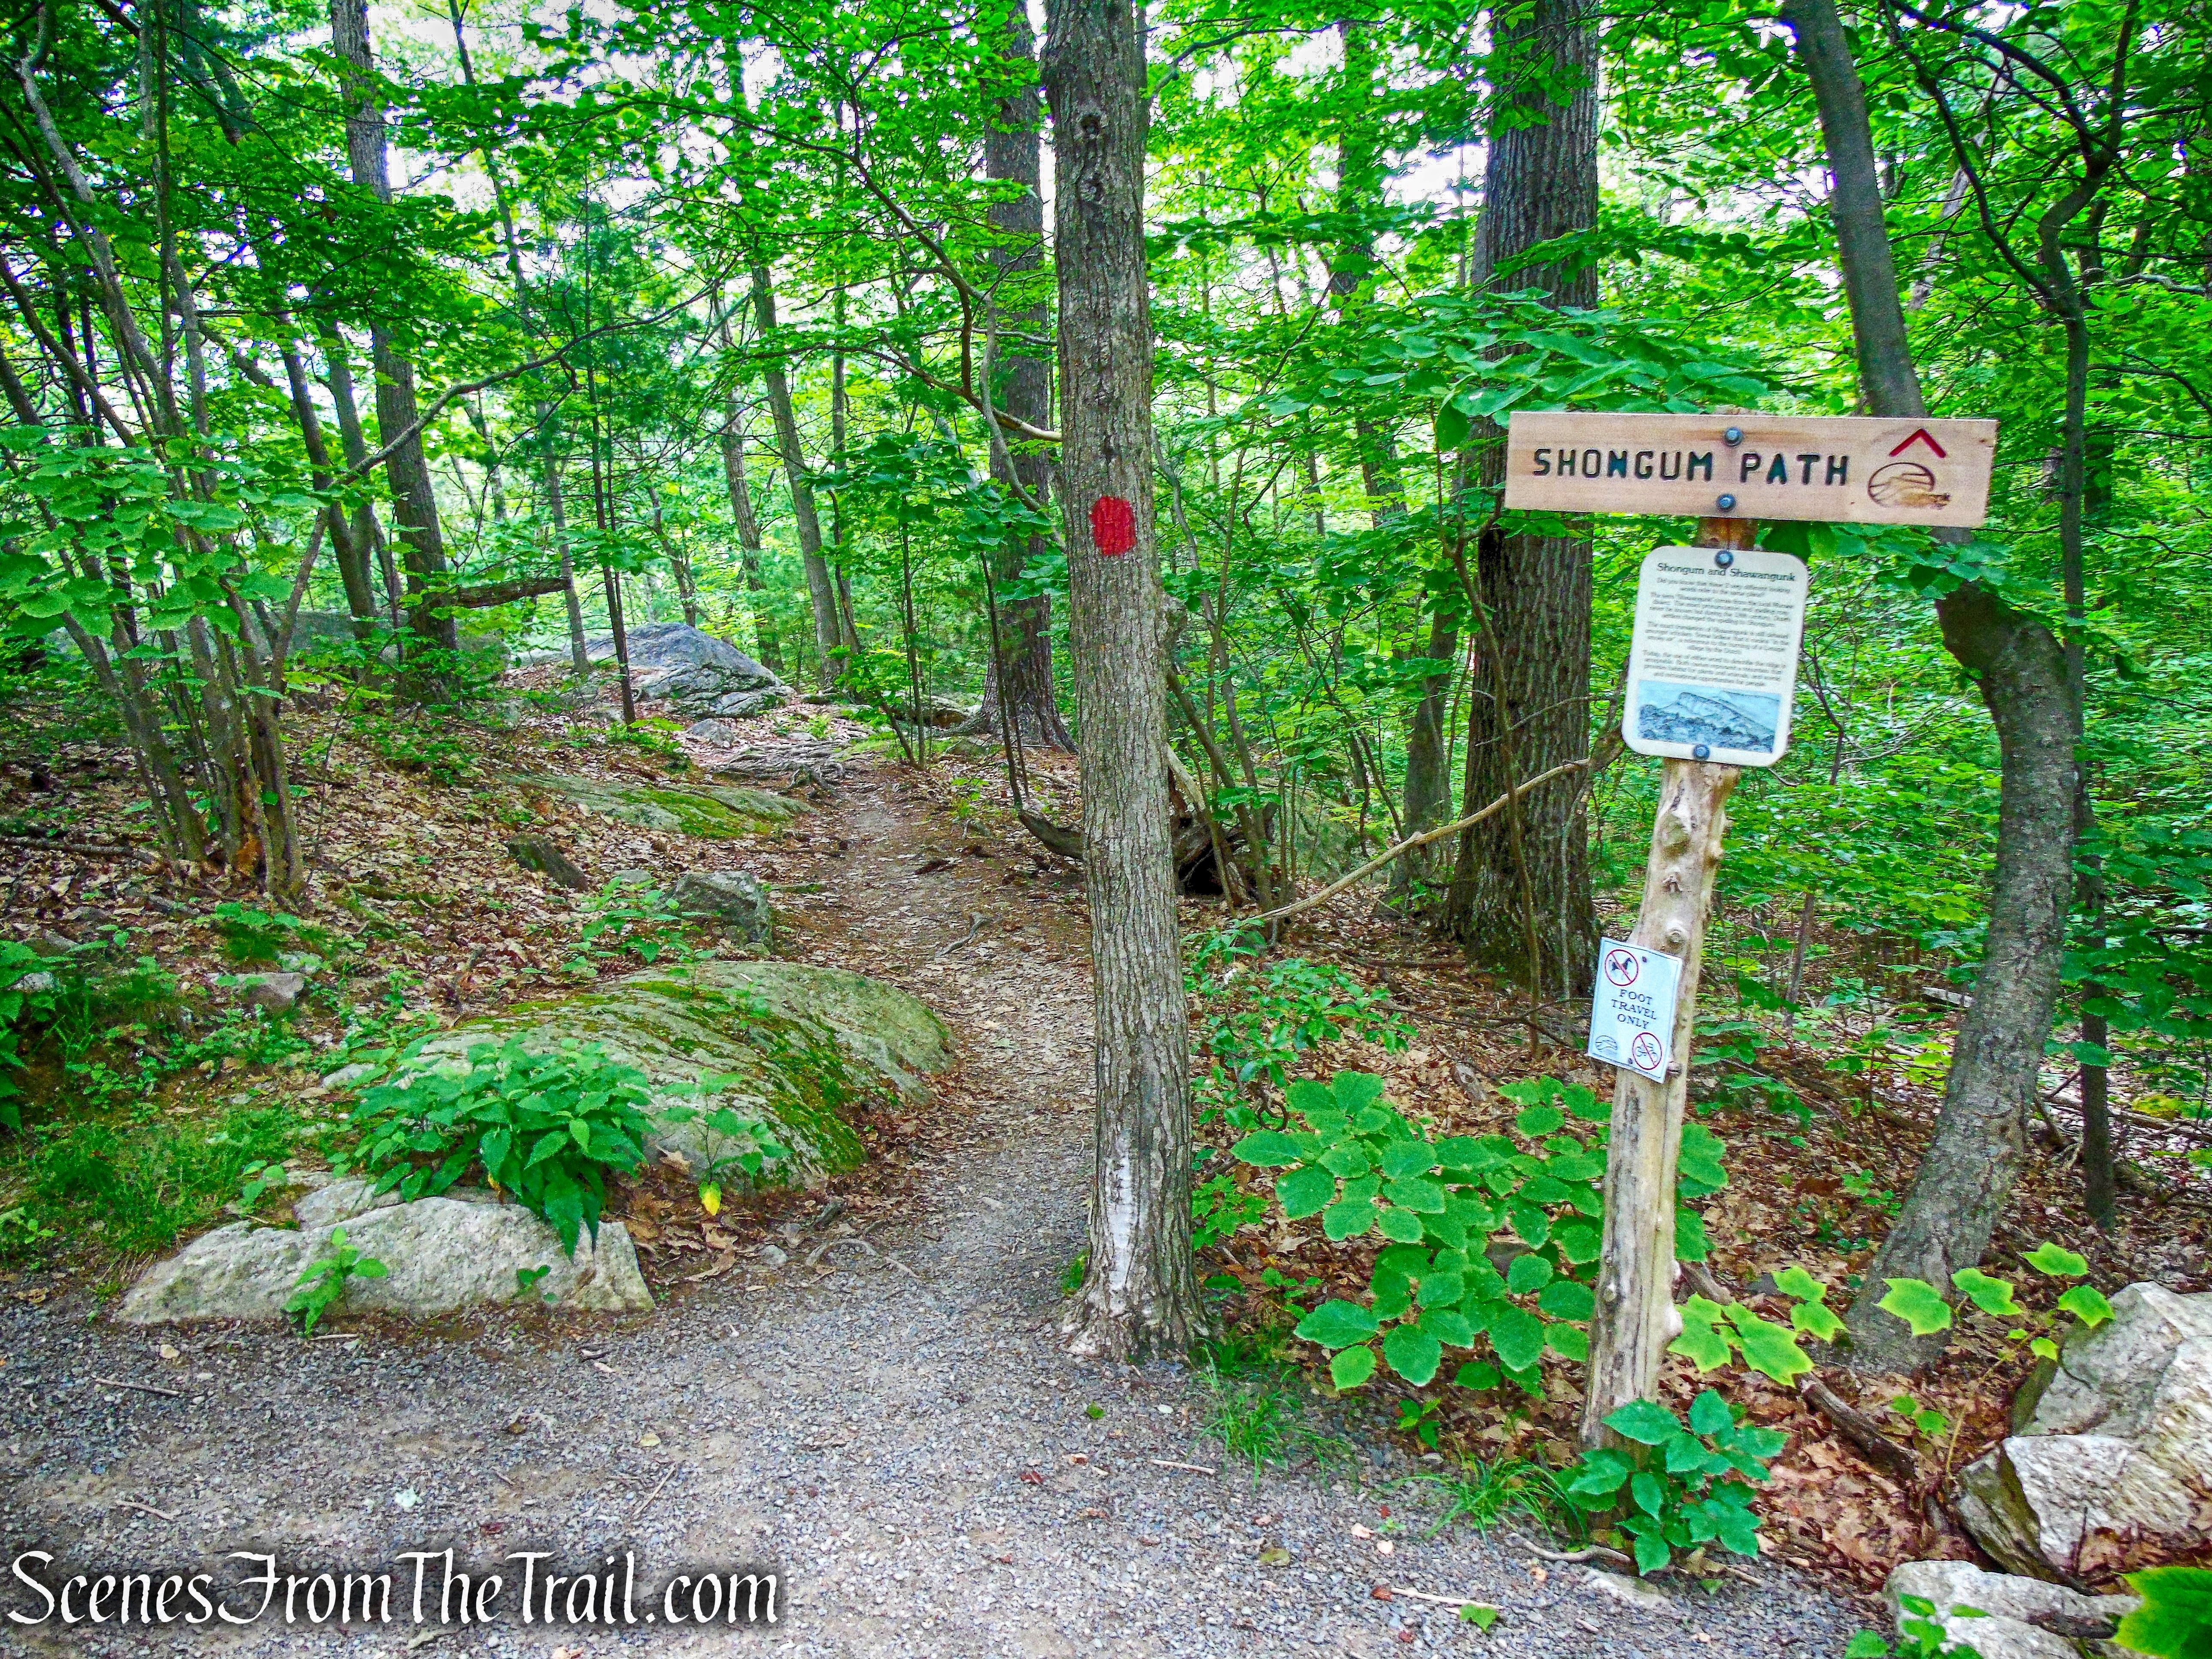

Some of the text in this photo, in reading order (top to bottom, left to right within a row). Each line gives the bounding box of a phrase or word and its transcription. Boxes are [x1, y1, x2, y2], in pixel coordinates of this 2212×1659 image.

[1533, 447, 1849, 486] SHONGUM PATH
[1658, 563, 1795, 581] Shongum and Shawangunk
[1619, 989, 1652, 1005] FOOT
[1611, 999, 1656, 1020] TRAVEL
[1617, 1014, 1649, 1029] ONLY
